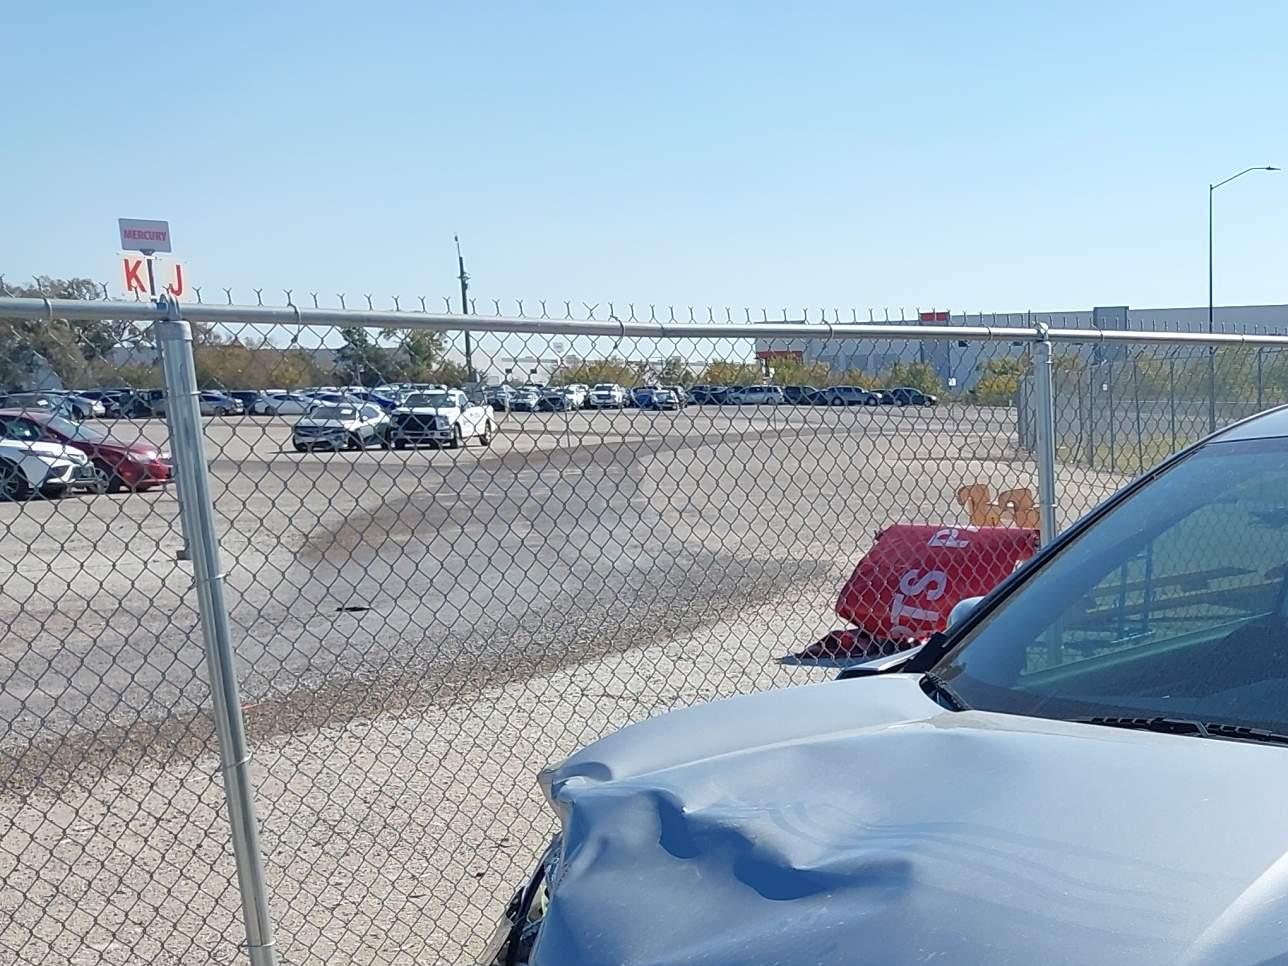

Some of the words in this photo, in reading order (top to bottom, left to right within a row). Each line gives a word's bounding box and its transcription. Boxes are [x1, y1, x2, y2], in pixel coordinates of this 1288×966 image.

[123, 230, 167, 241] MERCURY
[124, 259, 147, 293] K
[170, 264, 183, 297] J
